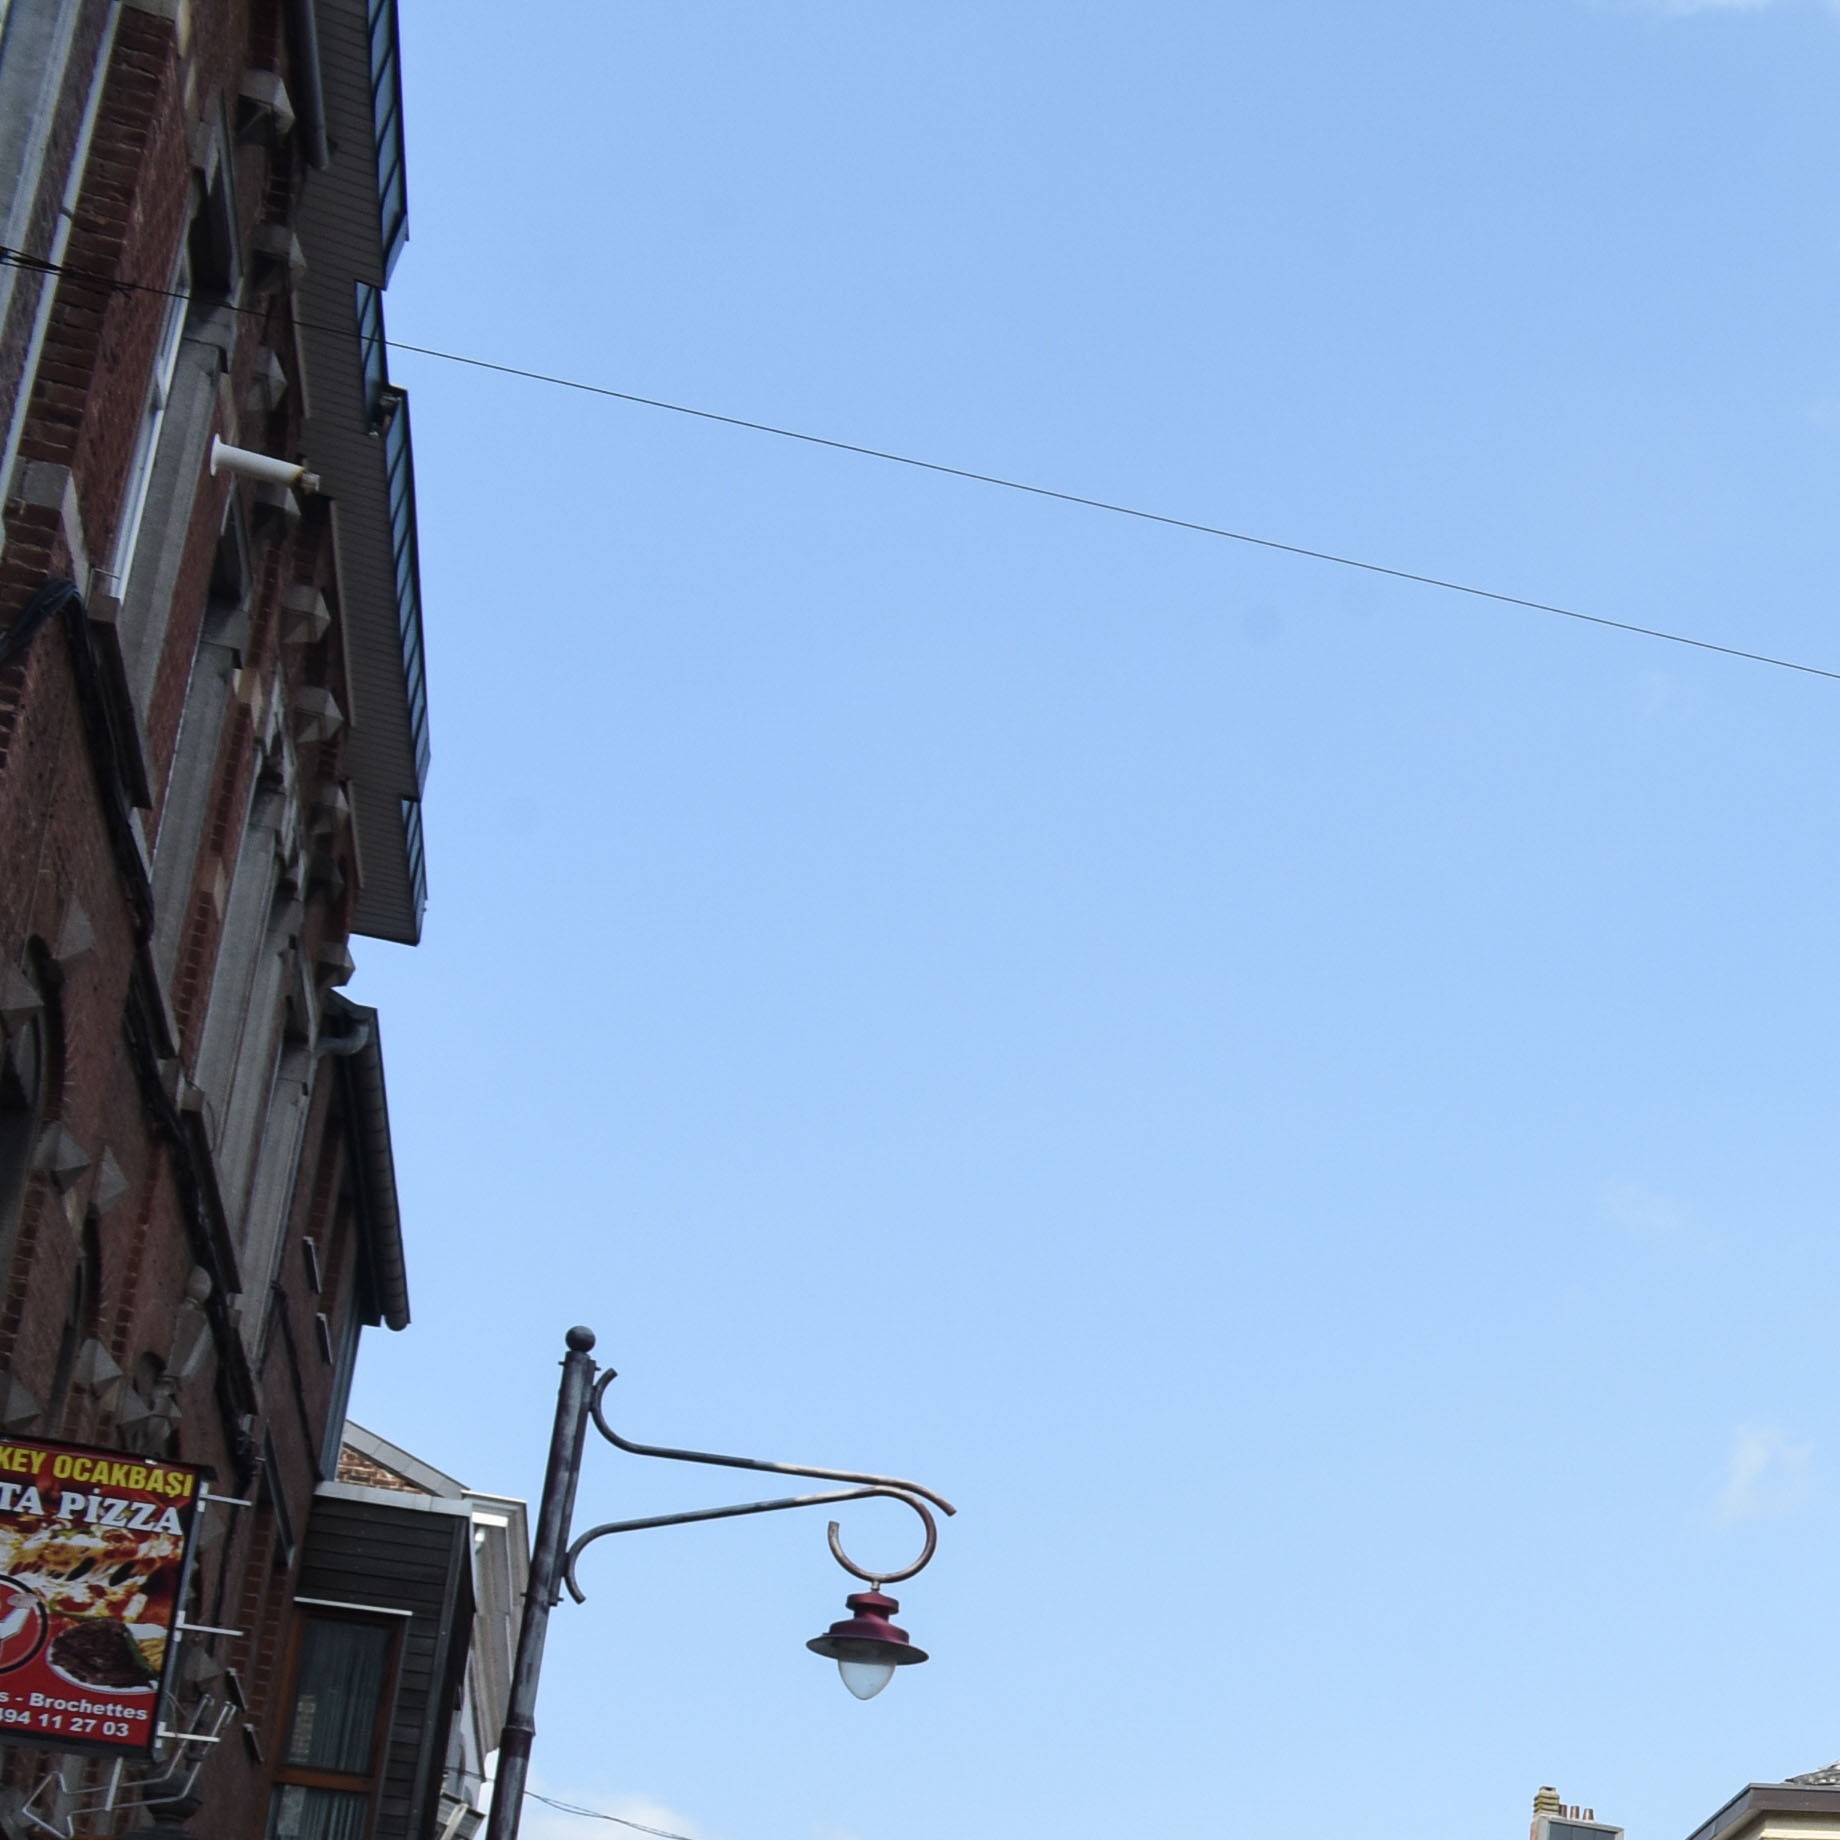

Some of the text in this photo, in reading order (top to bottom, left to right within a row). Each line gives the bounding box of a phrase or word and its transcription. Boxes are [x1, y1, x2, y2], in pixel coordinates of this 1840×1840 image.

[53, 1455, 195, 1498] OCAKBAŞI
[29, 1692, 148, 1720] Brochettes
[37, 1713, 62, 1729] 11
[69, 1717, 97, 1733] 27
[102, 1721, 129, 1737] 03
